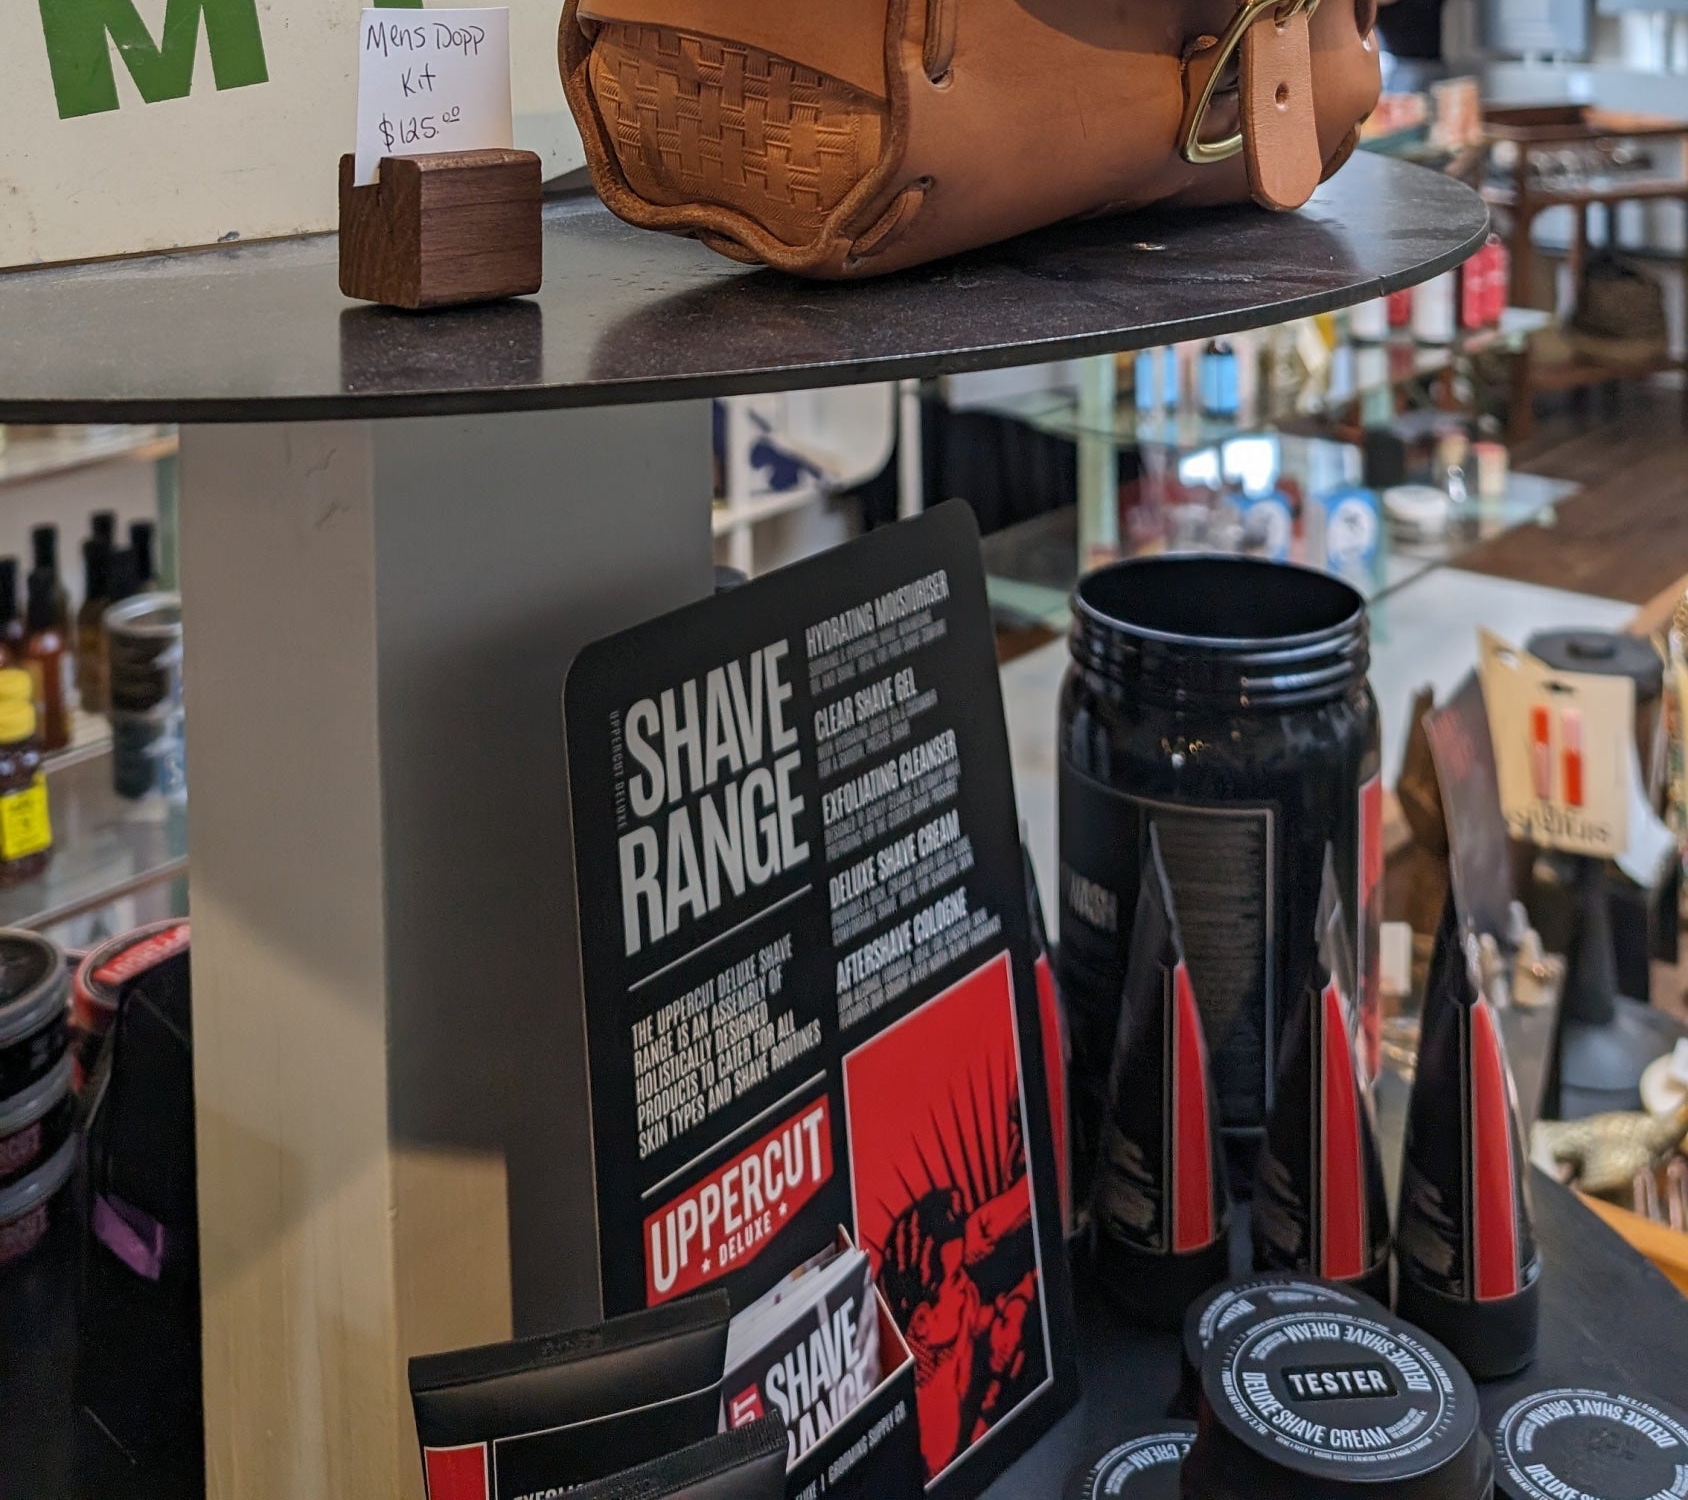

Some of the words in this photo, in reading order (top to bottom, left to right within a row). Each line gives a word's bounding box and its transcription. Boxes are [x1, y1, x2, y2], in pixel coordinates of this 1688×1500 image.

[367, 21, 426, 57] Mens
[432, 23, 485, 56] Dopp
[402, 63, 436, 97] Kit
[805, 601, 876, 658] HYDRATING
[625, 638, 798, 818] SHAVE
[814, 696, 856, 742] CLEAR
[854, 676, 894, 721] SHAVE
[894, 666, 918, 701] GEL
[822, 759, 899, 825] EXFOLIATING
[899, 728, 958, 783] CLEANSER
[618, 749, 810, 957] RANGE
[829, 855, 876, 910] DELUXE
[876, 832, 918, 882] SHAVE
[917, 808, 961, 858] CREAM
[836, 919, 913, 995] AFTERSHAVE
[913, 885, 968, 946] COLOGNE
[631, 1015, 654, 1050] THE
[656, 978, 715, 1035] UPPERCUT
[716, 954, 757, 999] DELUXE
[758, 933, 793, 975] SHAVE
[634, 1031, 674, 1077] RANGE
[677, 1022, 690, 1050] IS
[692, 1011, 709, 1044] AN
[711, 974, 767, 1030] ASSEMBLY
[768, 965, 783, 996] OF
[636, 1034, 713, 1103] HOLISTICALLY
[715, 1000, 769, 1054] DESIGNED
[637, 1071, 699, 1132] PRODUCTS
[700, 1060, 715, 1091] TO
[717, 1037, 752, 1079] CATER
[753, 1022, 776, 1056] FOR
[777, 1008, 796, 1042] ALL
[639, 1115, 669, 1160] SKIN
[670, 1094, 706, 1139] TYPES
[708, 1077, 733, 1115] AND
[733, 1052, 770, 1097] SHAVE
[771, 1018, 823, 1073] ROUTINES
[651, 1106, 825, 1293] UPPERCUT
[718, 1210, 772, 1268] DELUXE
[765, 1296, 861, 1427] SHAVE
[1283, 1321, 1341, 1343] CREAM
[1343, 1323, 1396, 1354] SHAVE
[1386, 1348, 1432, 1391] DELUXE
[1242, 1371, 1284, 1418] DELUXE
[1272, 1409, 1326, 1444] SHAVE
[1329, 1426, 1392, 1449] CREAM
[1287, 1369, 1389, 1397] TESTER
[1525, 1399, 1576, 1428] CREAM
[1573, 1399, 1624, 1421] SHAVE
[1126, 1444, 1180, 1471] CREAM
[1622, 1409, 1679, 1449] DELUXE
